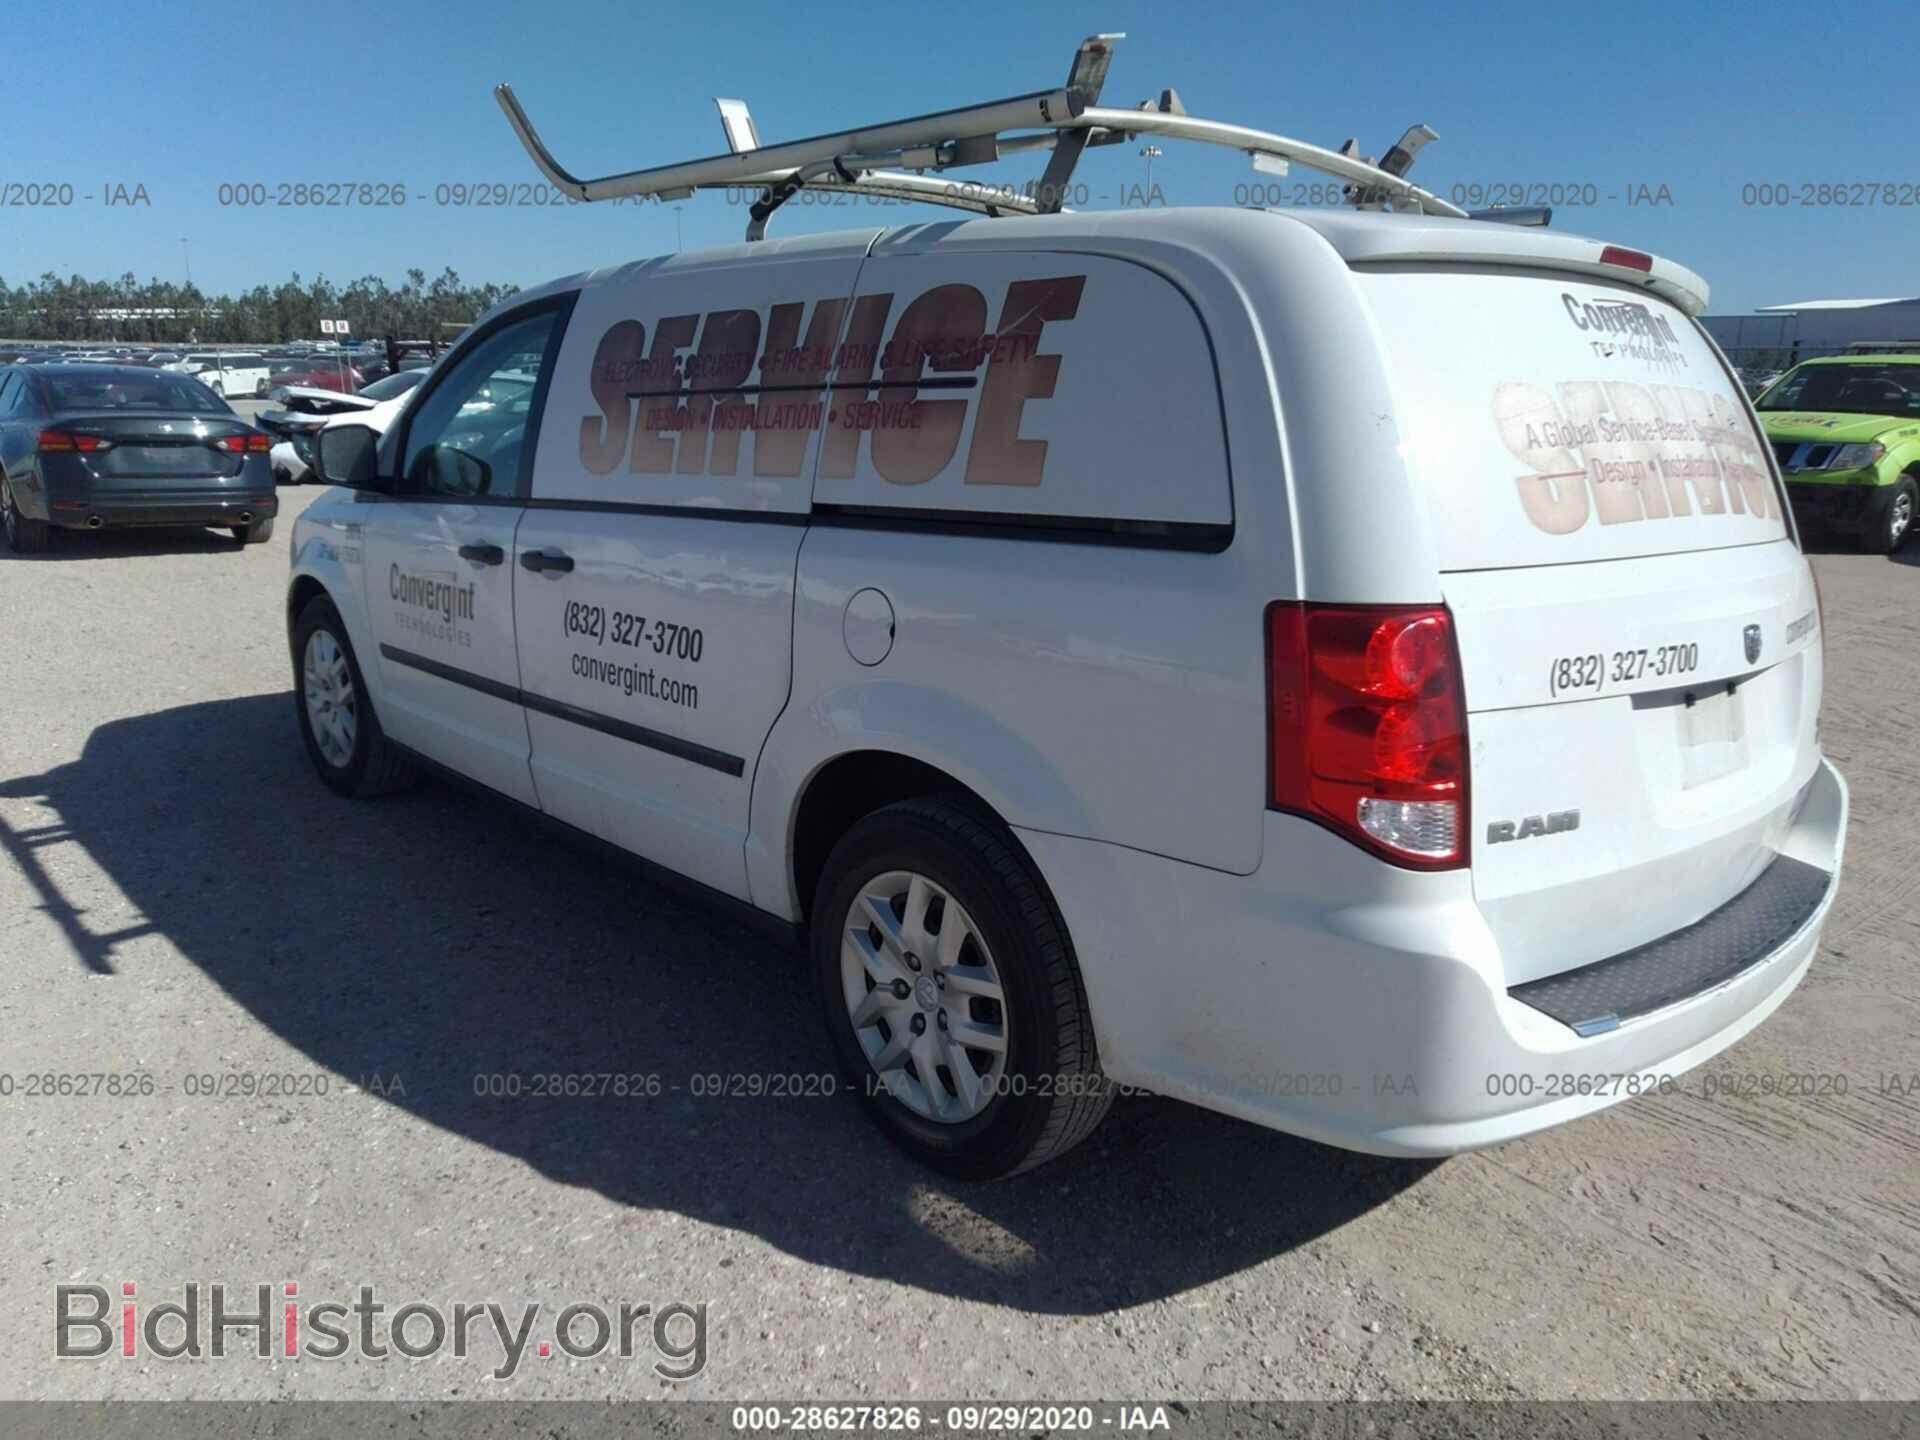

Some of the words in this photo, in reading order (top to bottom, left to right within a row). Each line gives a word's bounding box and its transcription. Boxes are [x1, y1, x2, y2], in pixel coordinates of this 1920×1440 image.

[712, 402, 822, 430] INSTALLATION
[843, 401, 923, 430] SERVICE
[1525, 423, 1543, 449] A
[1543, 417, 1598, 449] Global
[1590, 456, 1648, 486] Design
[390, 562, 475, 623] Convergint
[563, 600, 606, 646] (832)
[611, 611, 704, 663] 327-3700
[572, 652, 699, 709] convergint.com
[1549, 652, 1605, 697] (832)
[1611, 642, 1698, 681] 327-3700
[1486, 809, 1581, 845] RAM
